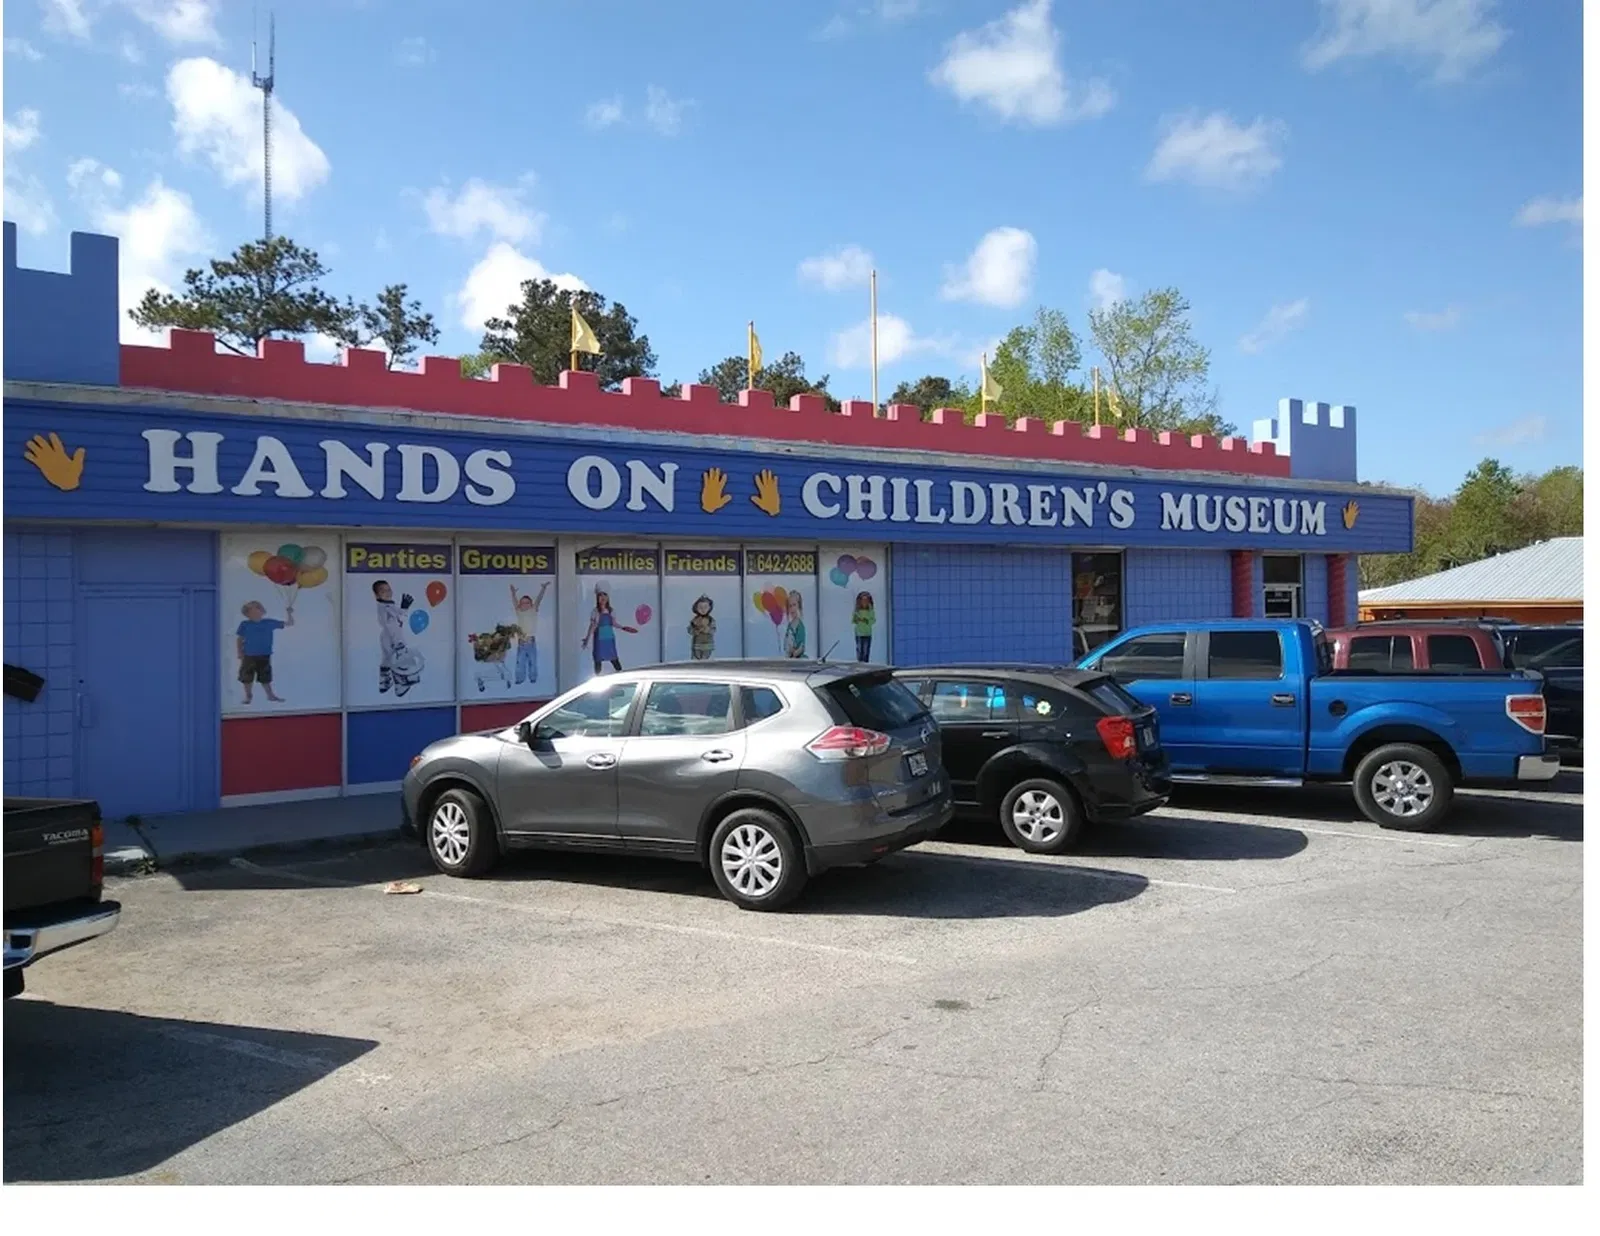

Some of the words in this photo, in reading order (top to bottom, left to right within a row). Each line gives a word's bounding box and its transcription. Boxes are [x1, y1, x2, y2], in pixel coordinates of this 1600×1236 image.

[142, 429, 516, 506] HANDS
[567, 455, 680, 512] ON
[802, 472, 1136, 530] CHILDREN'S
[1160, 492, 1328, 536] MUSEUM
[350, 547, 446, 569] Parties
[463, 550, 549, 573] Groups
[578, 553, 655, 570] Families
[667, 554, 736, 571] Friends
[42, 829, 89, 841] TACOMA
